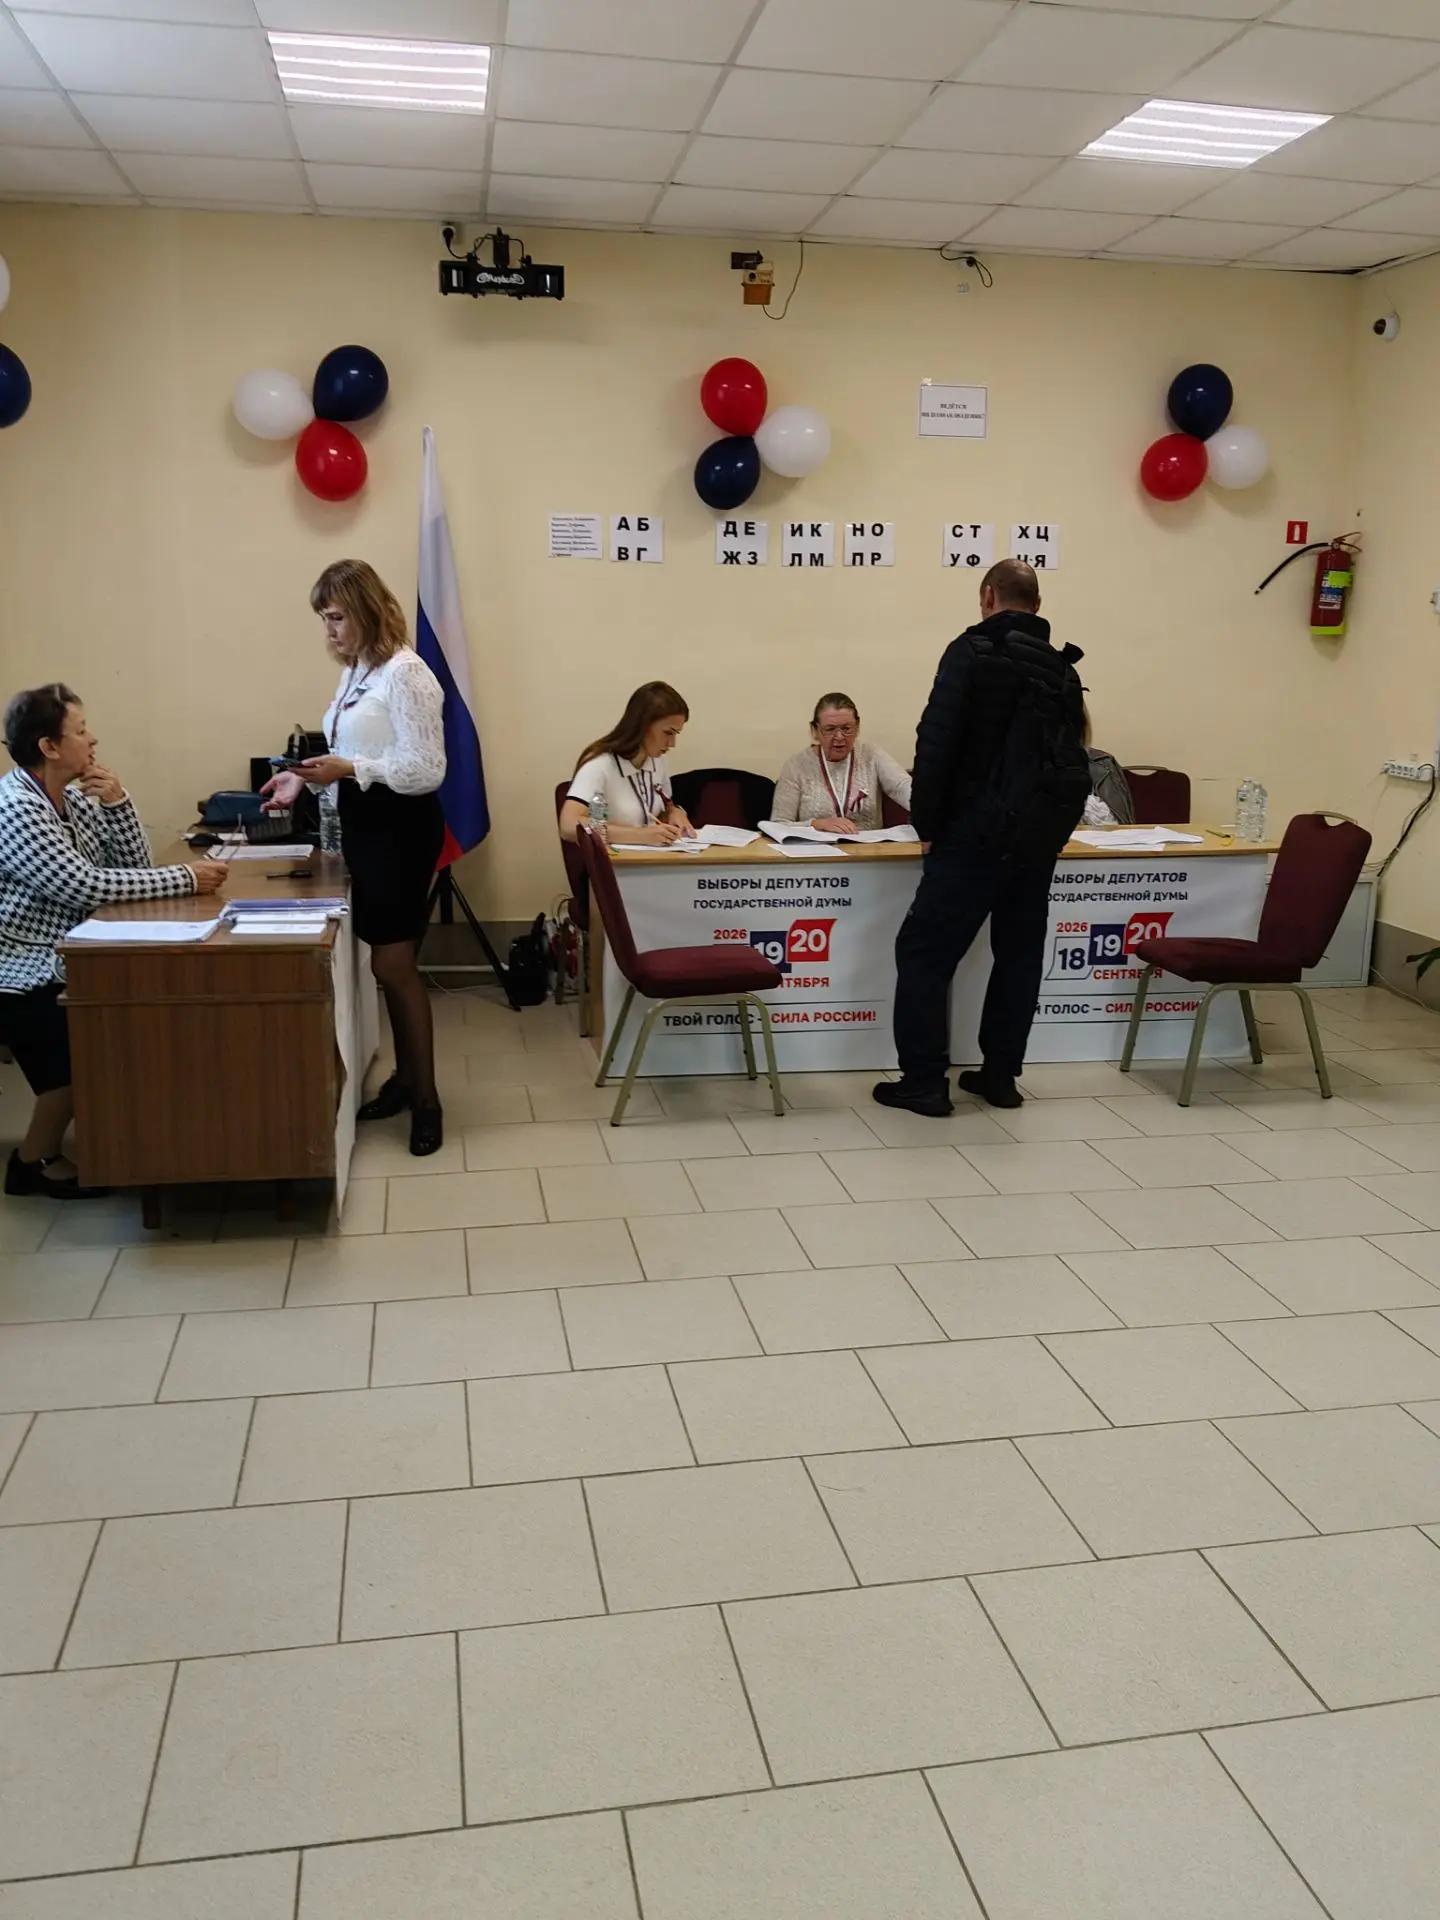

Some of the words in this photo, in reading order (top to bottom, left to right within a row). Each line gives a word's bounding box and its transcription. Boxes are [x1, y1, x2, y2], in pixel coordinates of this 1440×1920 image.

[697, 878, 762, 890] ВЫБОРЫ
[765, 877, 850, 890] ДЕПУТАТОВ
[1050, 873, 1105, 885] ЫБОРЫ
[1107, 872, 1188, 886] ДЕПУТАТОВ
[1047, 890, 1151, 903] ОСУДАРСТВЕННОЙ
[1153, 891, 1188, 902] ДУМЫ
[693, 897, 813, 910] ГОСУДАРСТВЕННОЙ
[815, 897, 852, 909] ДУМЫ
[1056, 922, 1088, 933] 2026
[713, 929, 747, 940] 2026
[790, 928, 827, 953] 20
[1058, 947, 1086, 970] 18
[1092, 934, 1121, 957] 19
[1127, 922, 1162, 945] 20
[779, 977, 830, 988] ТЯБРЯ
[1045, 1003, 1090, 1015] ГОЛОС
[1105, 1002, 1133, 1014] СИЛ
[663, 1012, 702, 1027] ТВОЙ
[771, 1012, 809, 1024] СИЛА
[815, 1010, 876, 1023] РОССИИ!
